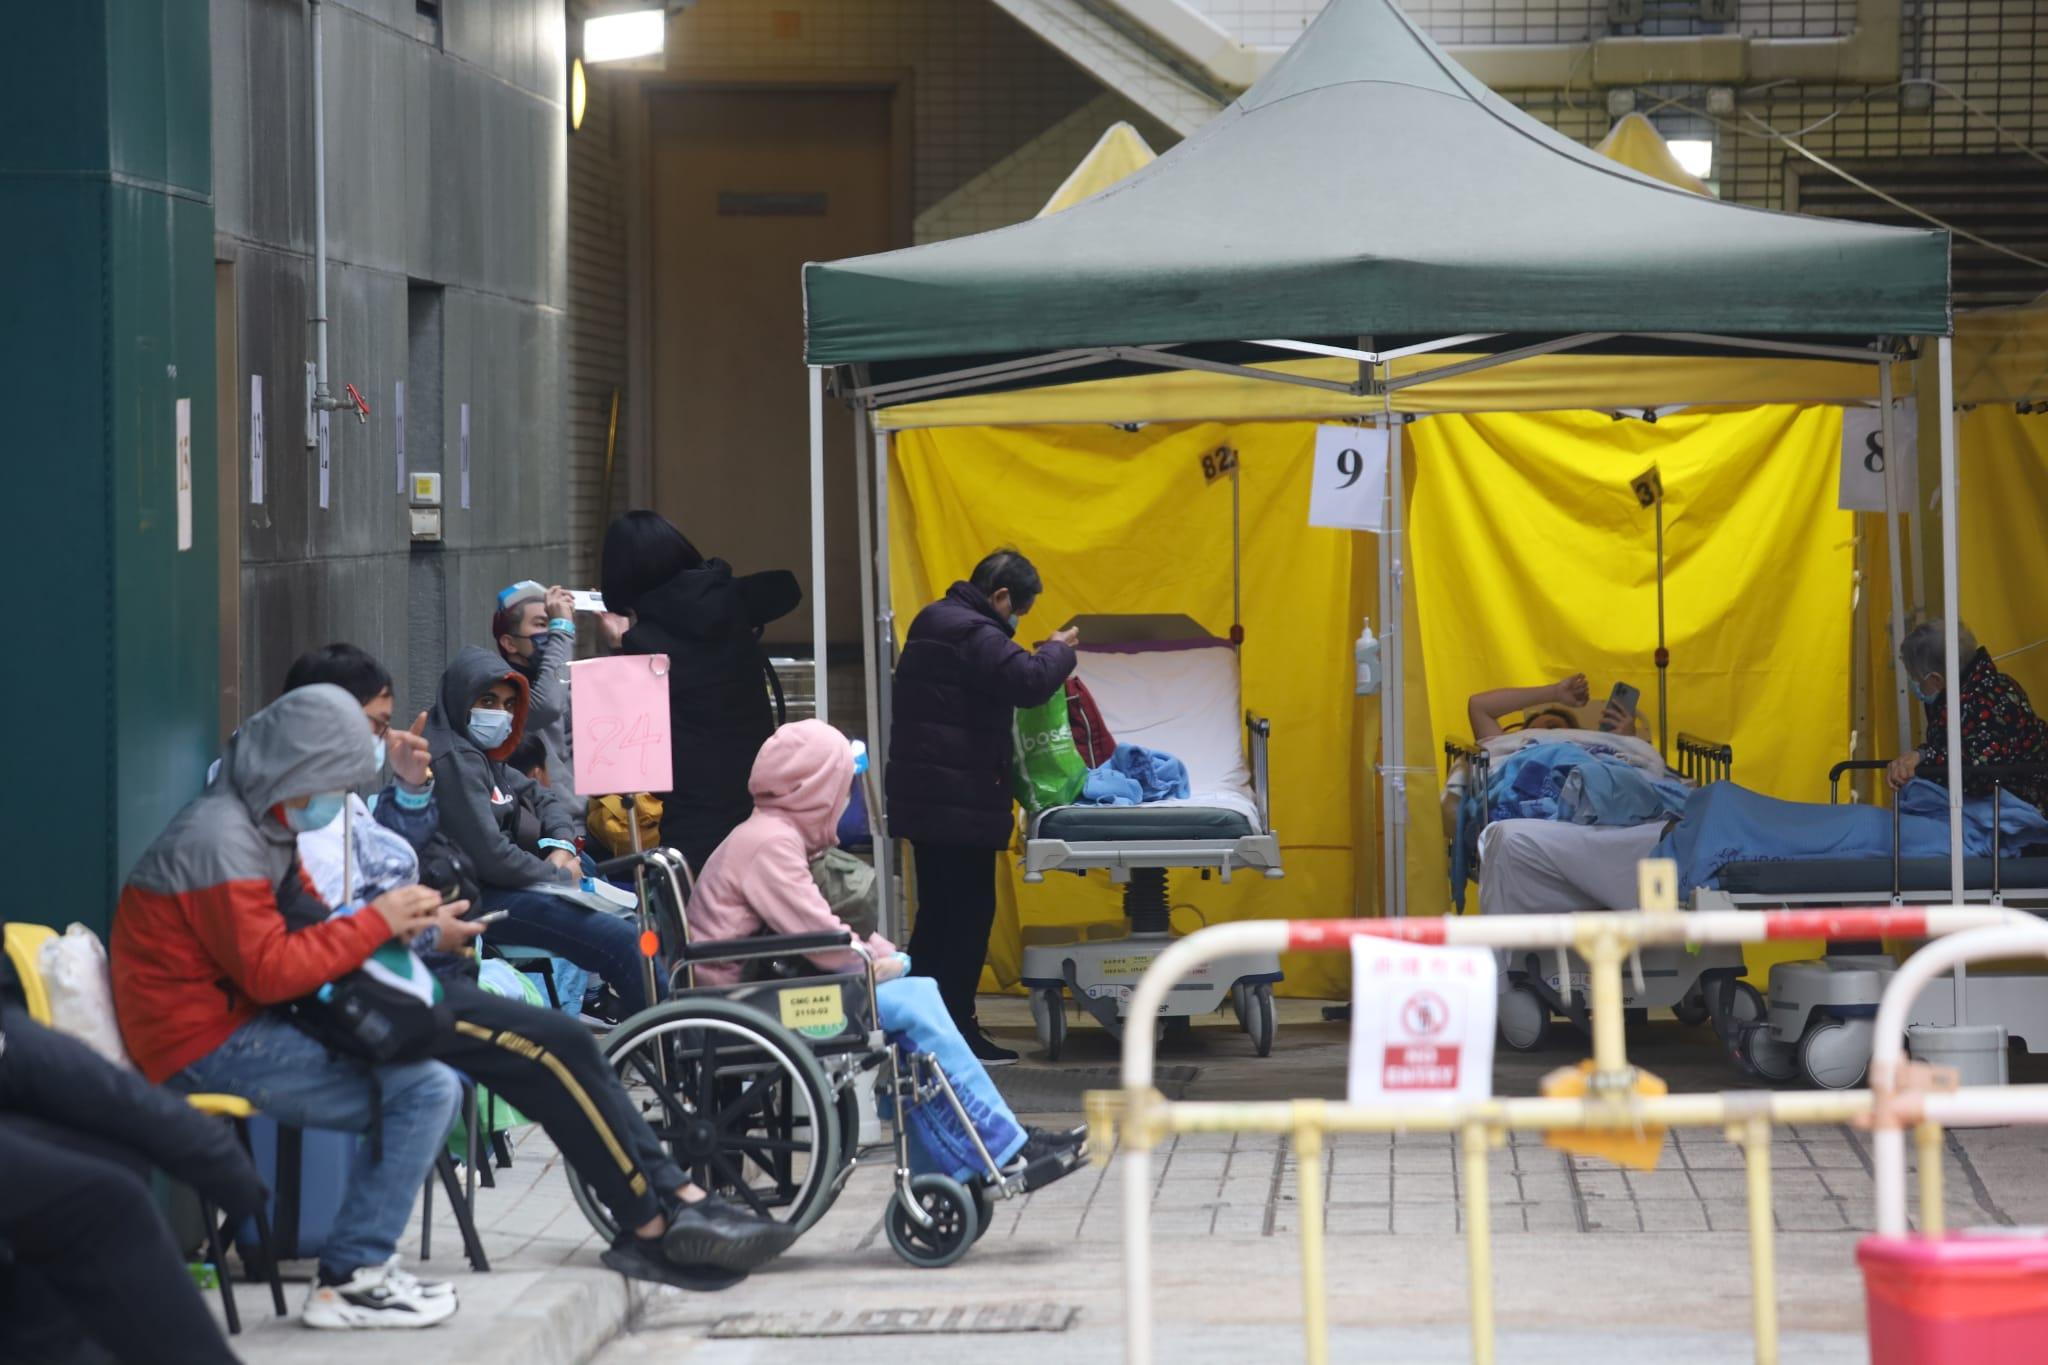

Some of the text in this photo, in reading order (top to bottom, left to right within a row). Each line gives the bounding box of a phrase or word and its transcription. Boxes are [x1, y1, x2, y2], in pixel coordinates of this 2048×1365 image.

[1201, 445, 1238, 479] 82
[1335, 448, 1364, 490] 9
[1863, 429, 1885, 473] 8
[586, 712, 664, 776] 24
